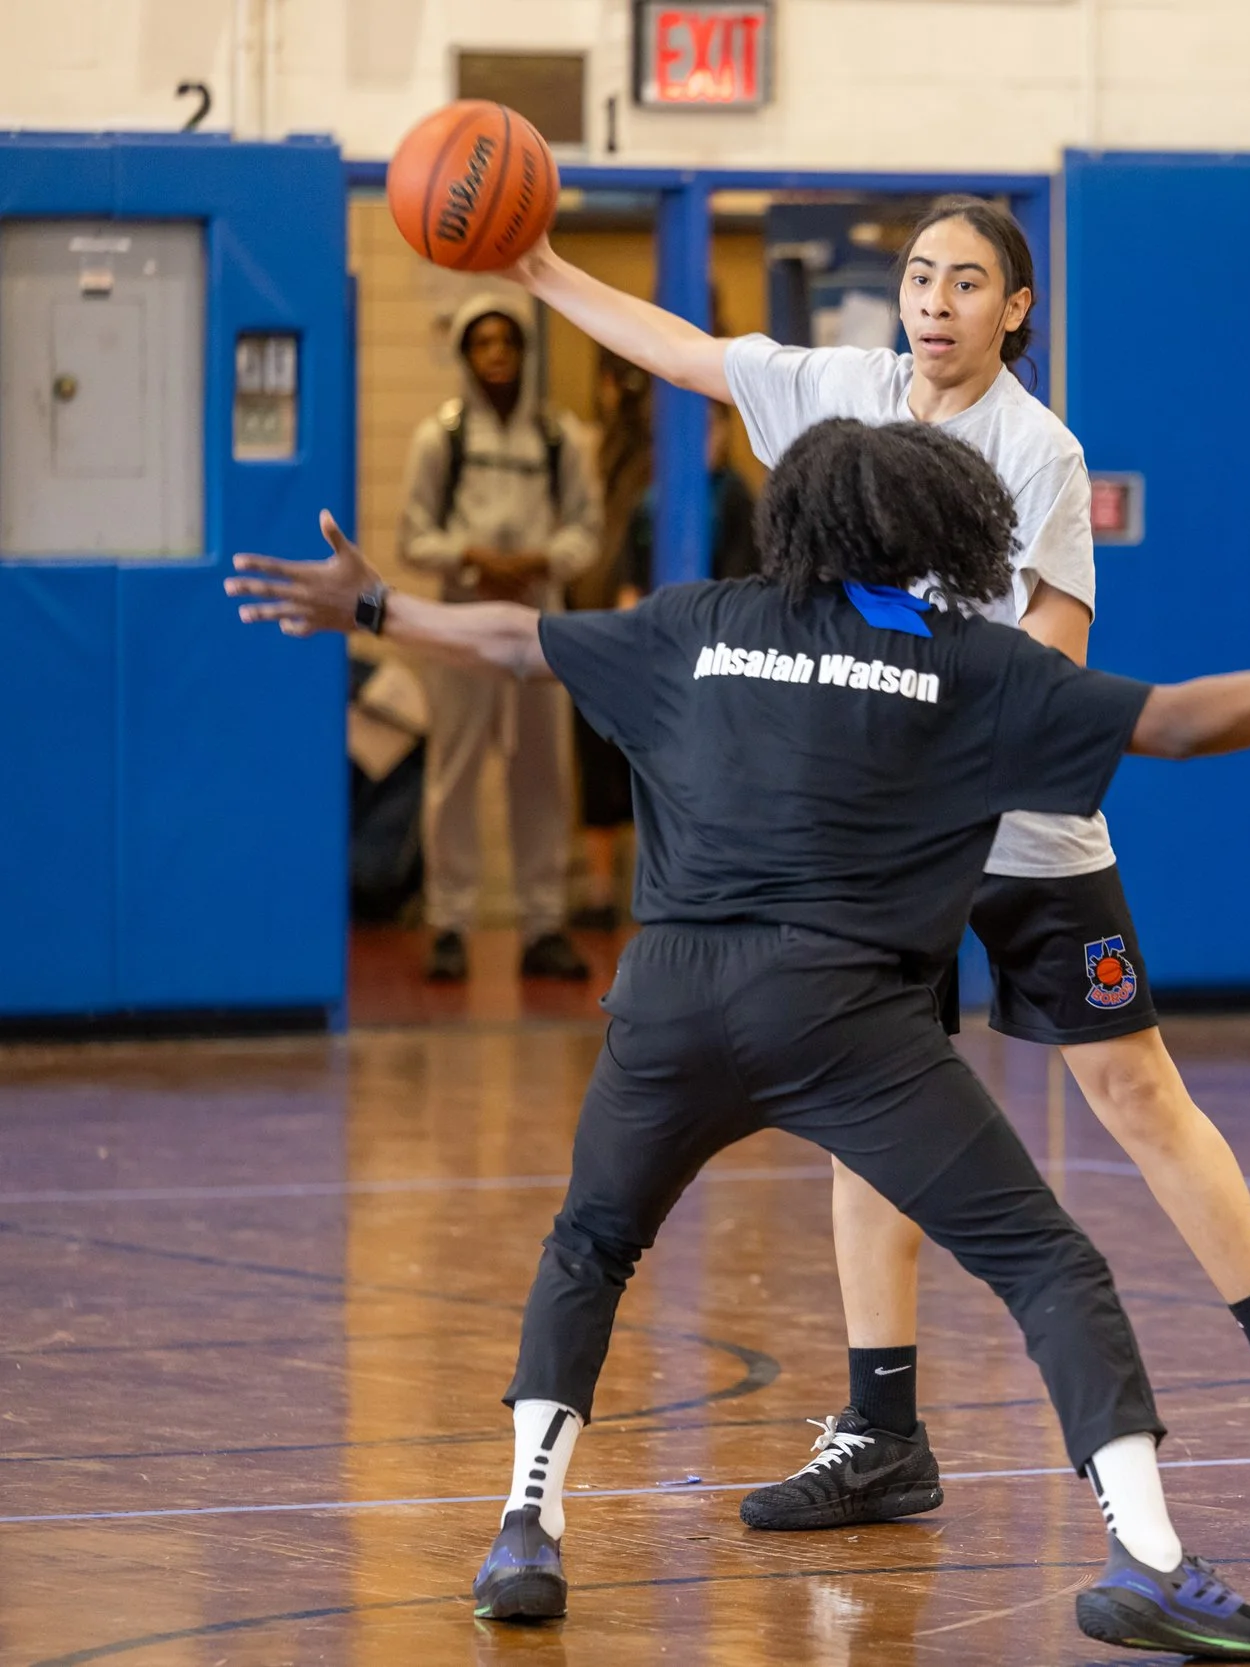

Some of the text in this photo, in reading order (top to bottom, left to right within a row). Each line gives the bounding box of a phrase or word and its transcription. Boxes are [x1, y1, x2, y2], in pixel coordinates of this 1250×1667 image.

[655, 11, 766, 103] EXIT
[176, 82, 211, 133] 2
[436, 134, 496, 243] Wilson
[817, 653, 940, 704] Watson
[1090, 980, 1134, 1005] BOROS
